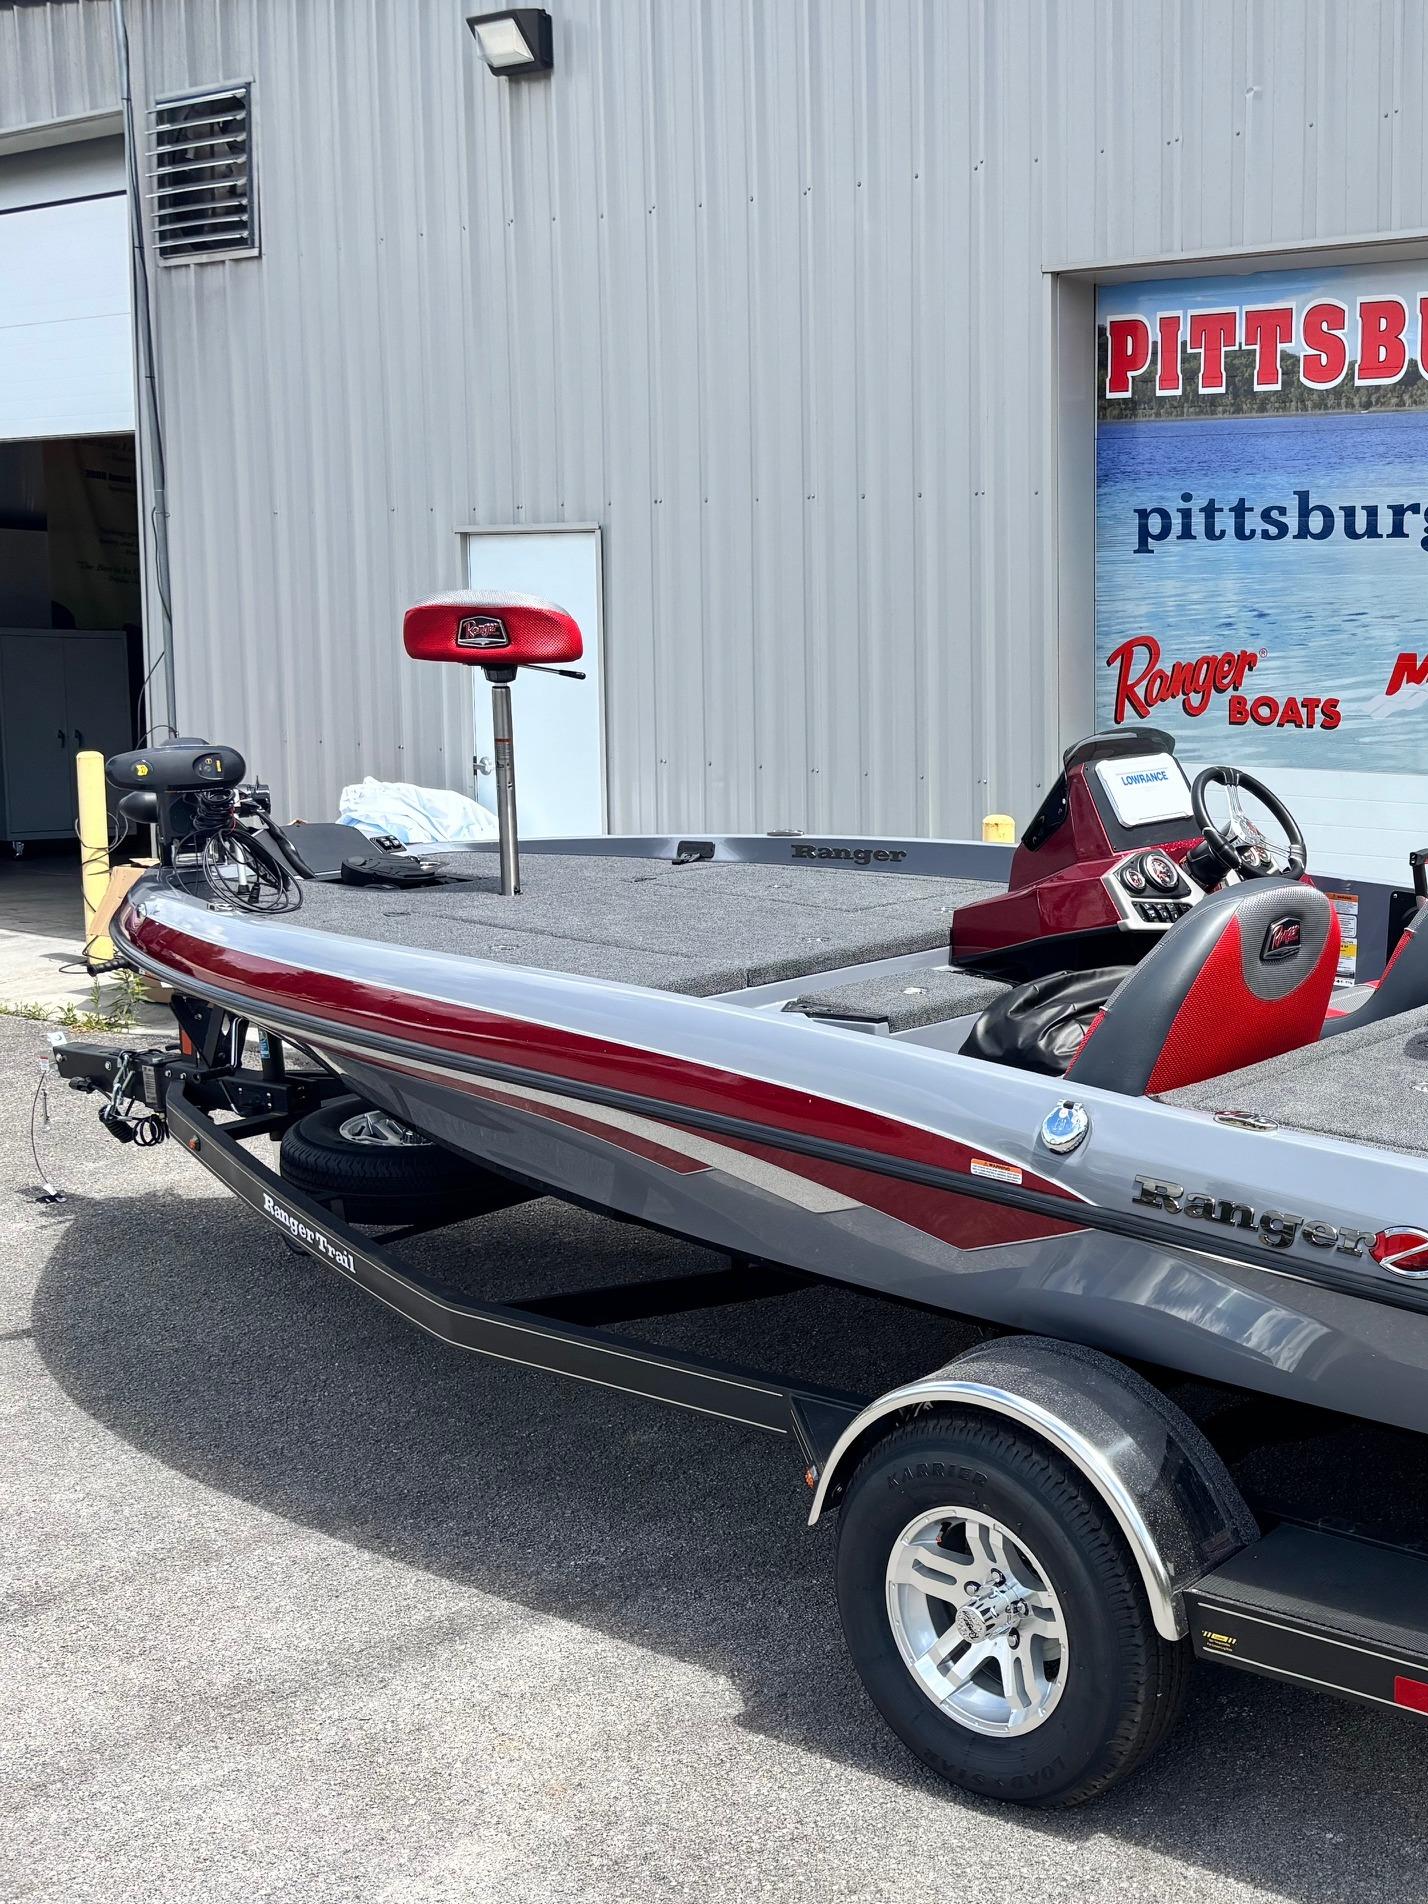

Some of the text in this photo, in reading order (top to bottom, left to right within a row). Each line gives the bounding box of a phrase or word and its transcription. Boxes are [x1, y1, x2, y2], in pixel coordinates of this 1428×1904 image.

[1106, 635, 1258, 724] Ranger
[1228, 694, 1342, 730] BOATS
[1121, 770, 1169, 786] LOWRANCE
[791, 844, 908, 866] Ranger
[262, 1192, 357, 1274] Ranger Trail
[1132, 1173, 1377, 1259] Ranger
